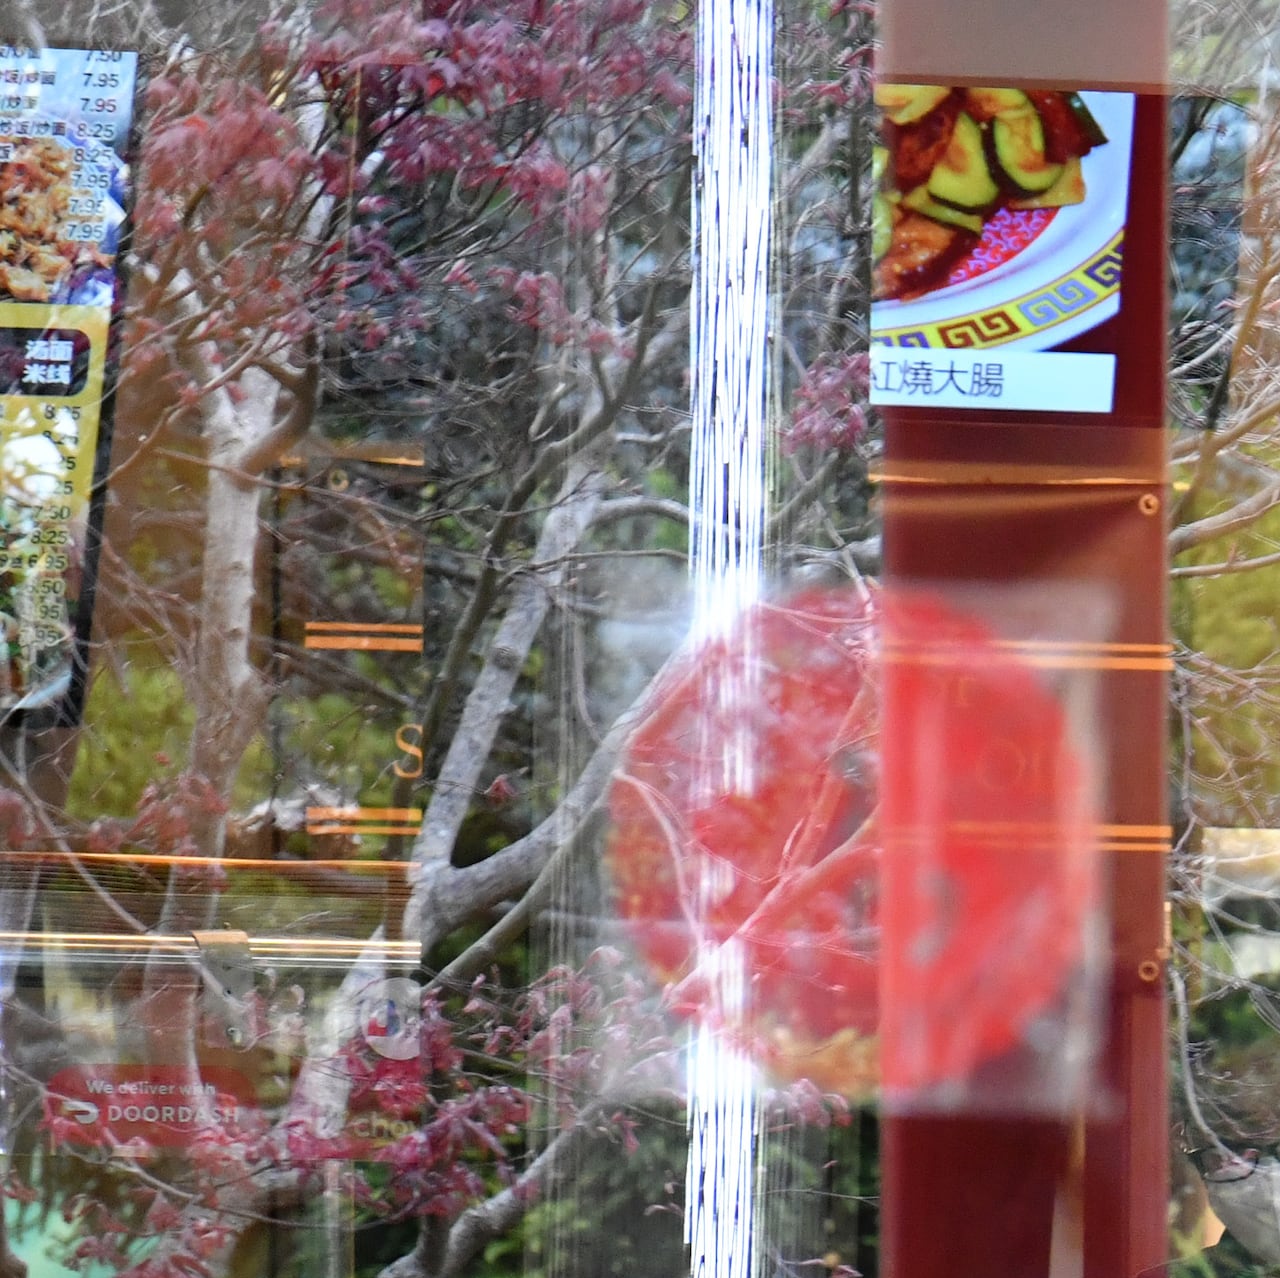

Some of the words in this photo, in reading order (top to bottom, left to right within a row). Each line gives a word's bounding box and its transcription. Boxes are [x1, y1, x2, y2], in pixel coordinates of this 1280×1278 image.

[82, 73, 120, 88] 7.95
[79, 97, 117, 113] 7.95
[76, 123, 115, 138] 8.25
[71, 173, 109, 189] 7.95
[67, 224, 104, 239] 7.95
[86, 1079, 112, 1095] We
[117, 1079, 175, 1095] deliver
[179, 1079, 217, 1095] with
[107, 1105, 240, 1123] DOORDASH
